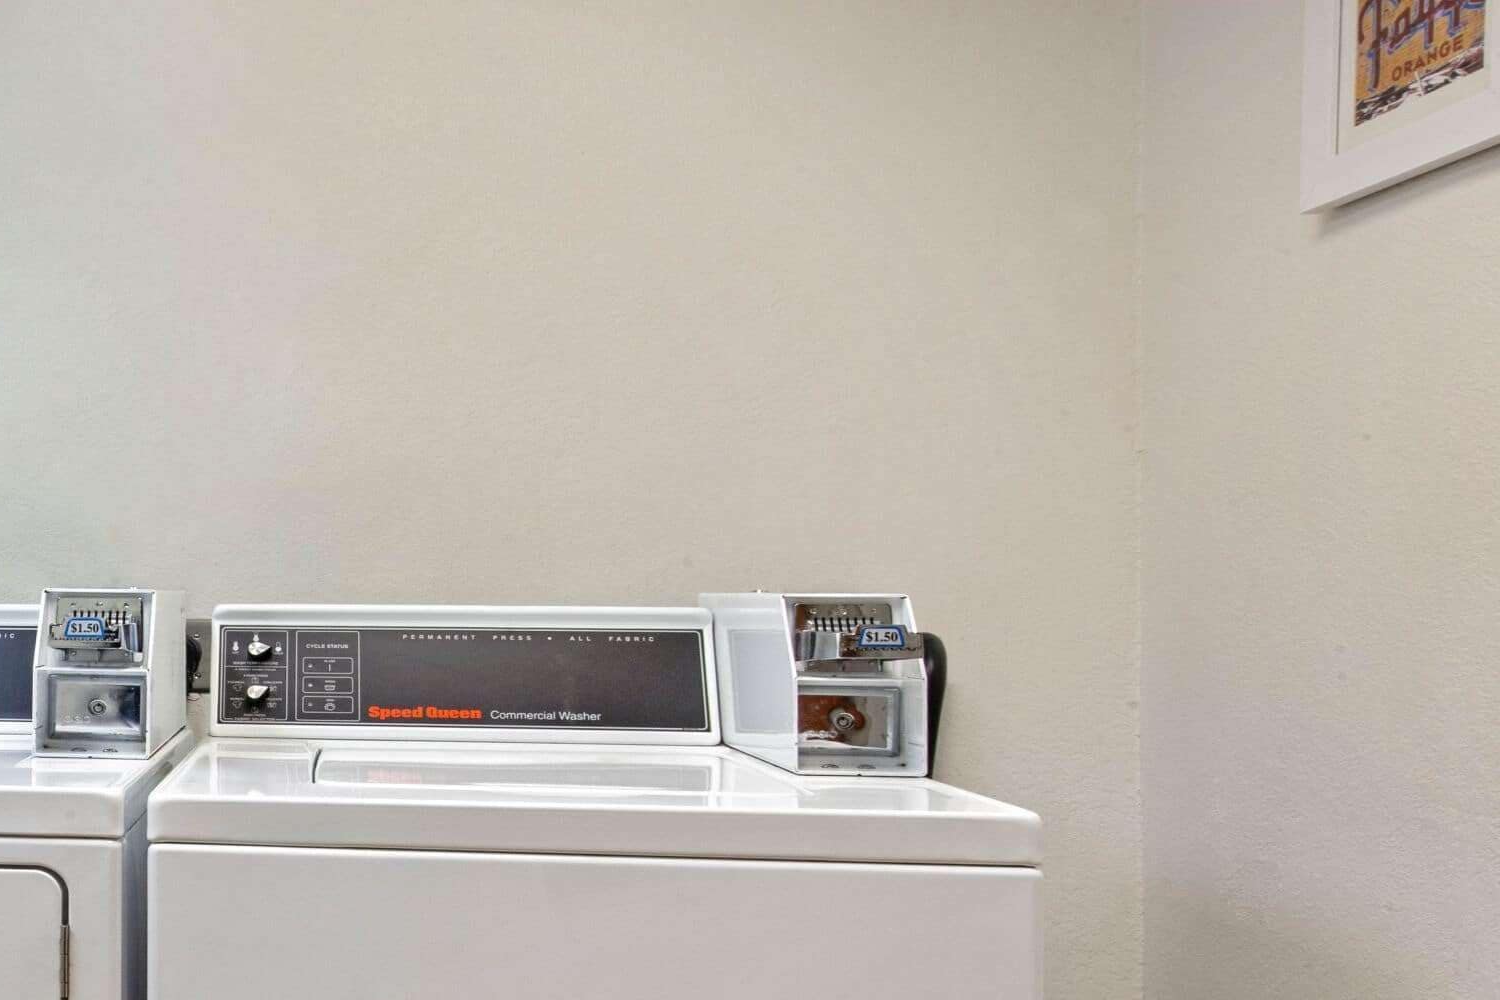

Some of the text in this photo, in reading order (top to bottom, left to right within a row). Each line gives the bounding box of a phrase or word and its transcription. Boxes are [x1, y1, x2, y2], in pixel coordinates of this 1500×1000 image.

[1391, 34, 1464, 81] ORANGE
[70, 622, 99, 634] $1.50
[865, 631, 898, 642] $1.50
[367, 706, 483, 720] Speed Queen
[490, 710, 602, 721] Commercial Washer
